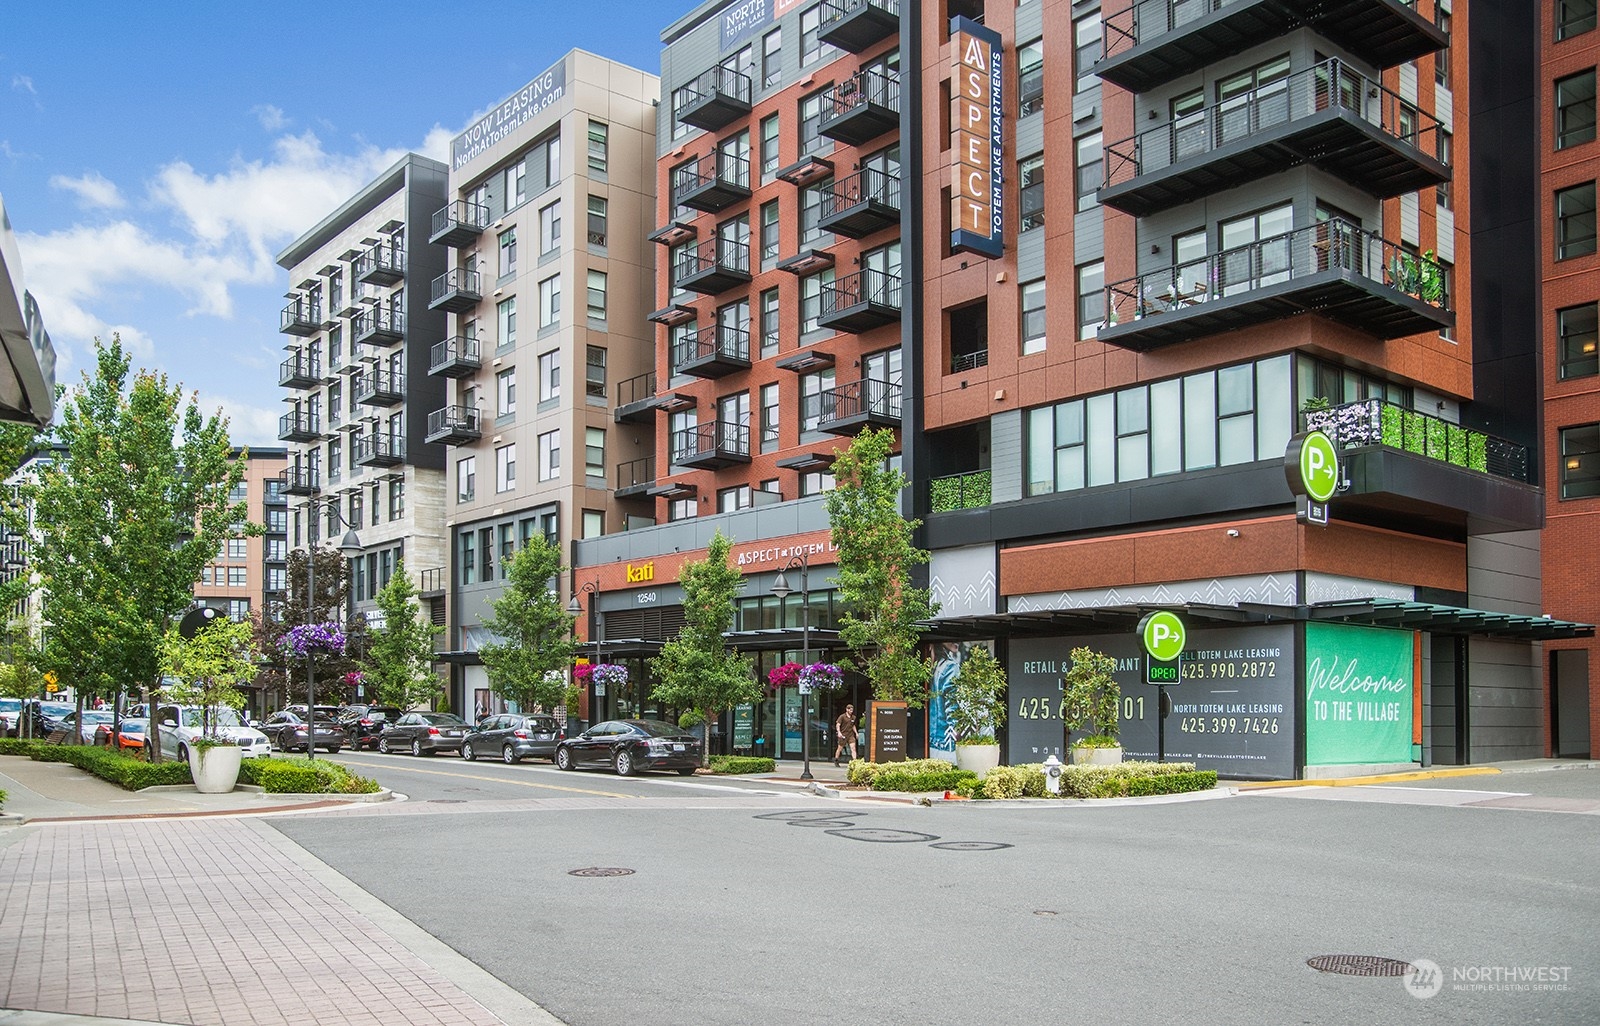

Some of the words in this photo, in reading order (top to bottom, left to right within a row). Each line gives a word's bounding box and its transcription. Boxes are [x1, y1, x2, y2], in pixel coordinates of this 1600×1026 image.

[726, 0, 765, 29] NORTH
[726, 20, 747, 38] TOTEM
[748, 9, 765, 24] LAKE
[464, 114, 493, 149] NOW
[496, 71, 553, 126] LEASING
[992, 52, 1002, 144] APARTMENTS
[455, 86, 563, 168] NorthAtTotemLake.com
[964, 37, 985, 229] ASPECT
[993, 146, 1002, 184] LAKE
[993, 187, 1002, 234] TOTEM
[1308, 446, 1324, 481] P
[737, 547, 780, 565] ASPECT
[627, 561, 654, 583] kati
[637, 592, 656, 603] 12540
[1153, 624, 1170, 649] P
[1197, 650, 1221, 660] TOTEM
[1224, 649, 1244, 659] LAKE
[1246, 648, 1281, 658] LEASING
[1024, 661, 1057, 674] RETAIL
[1061, 661, 1068, 673] &
[1150, 667, 1176, 679] OPEN
[1181, 661, 1276, 679] 425.990.2872
[1307, 655, 1407, 700] Welcome
[1173, 704, 1197, 713] NORTH
[1200, 704, 1224, 713] TOTEM
[1226, 704, 1246, 713] LAKE
[1249, 704, 1283, 713] LEASING
[1314, 700, 1327, 721] TO
[1332, 701, 1352, 721] THE
[1357, 701, 1400, 721] VILLAGE
[1181, 718, 1279, 734] 425.399.7426
